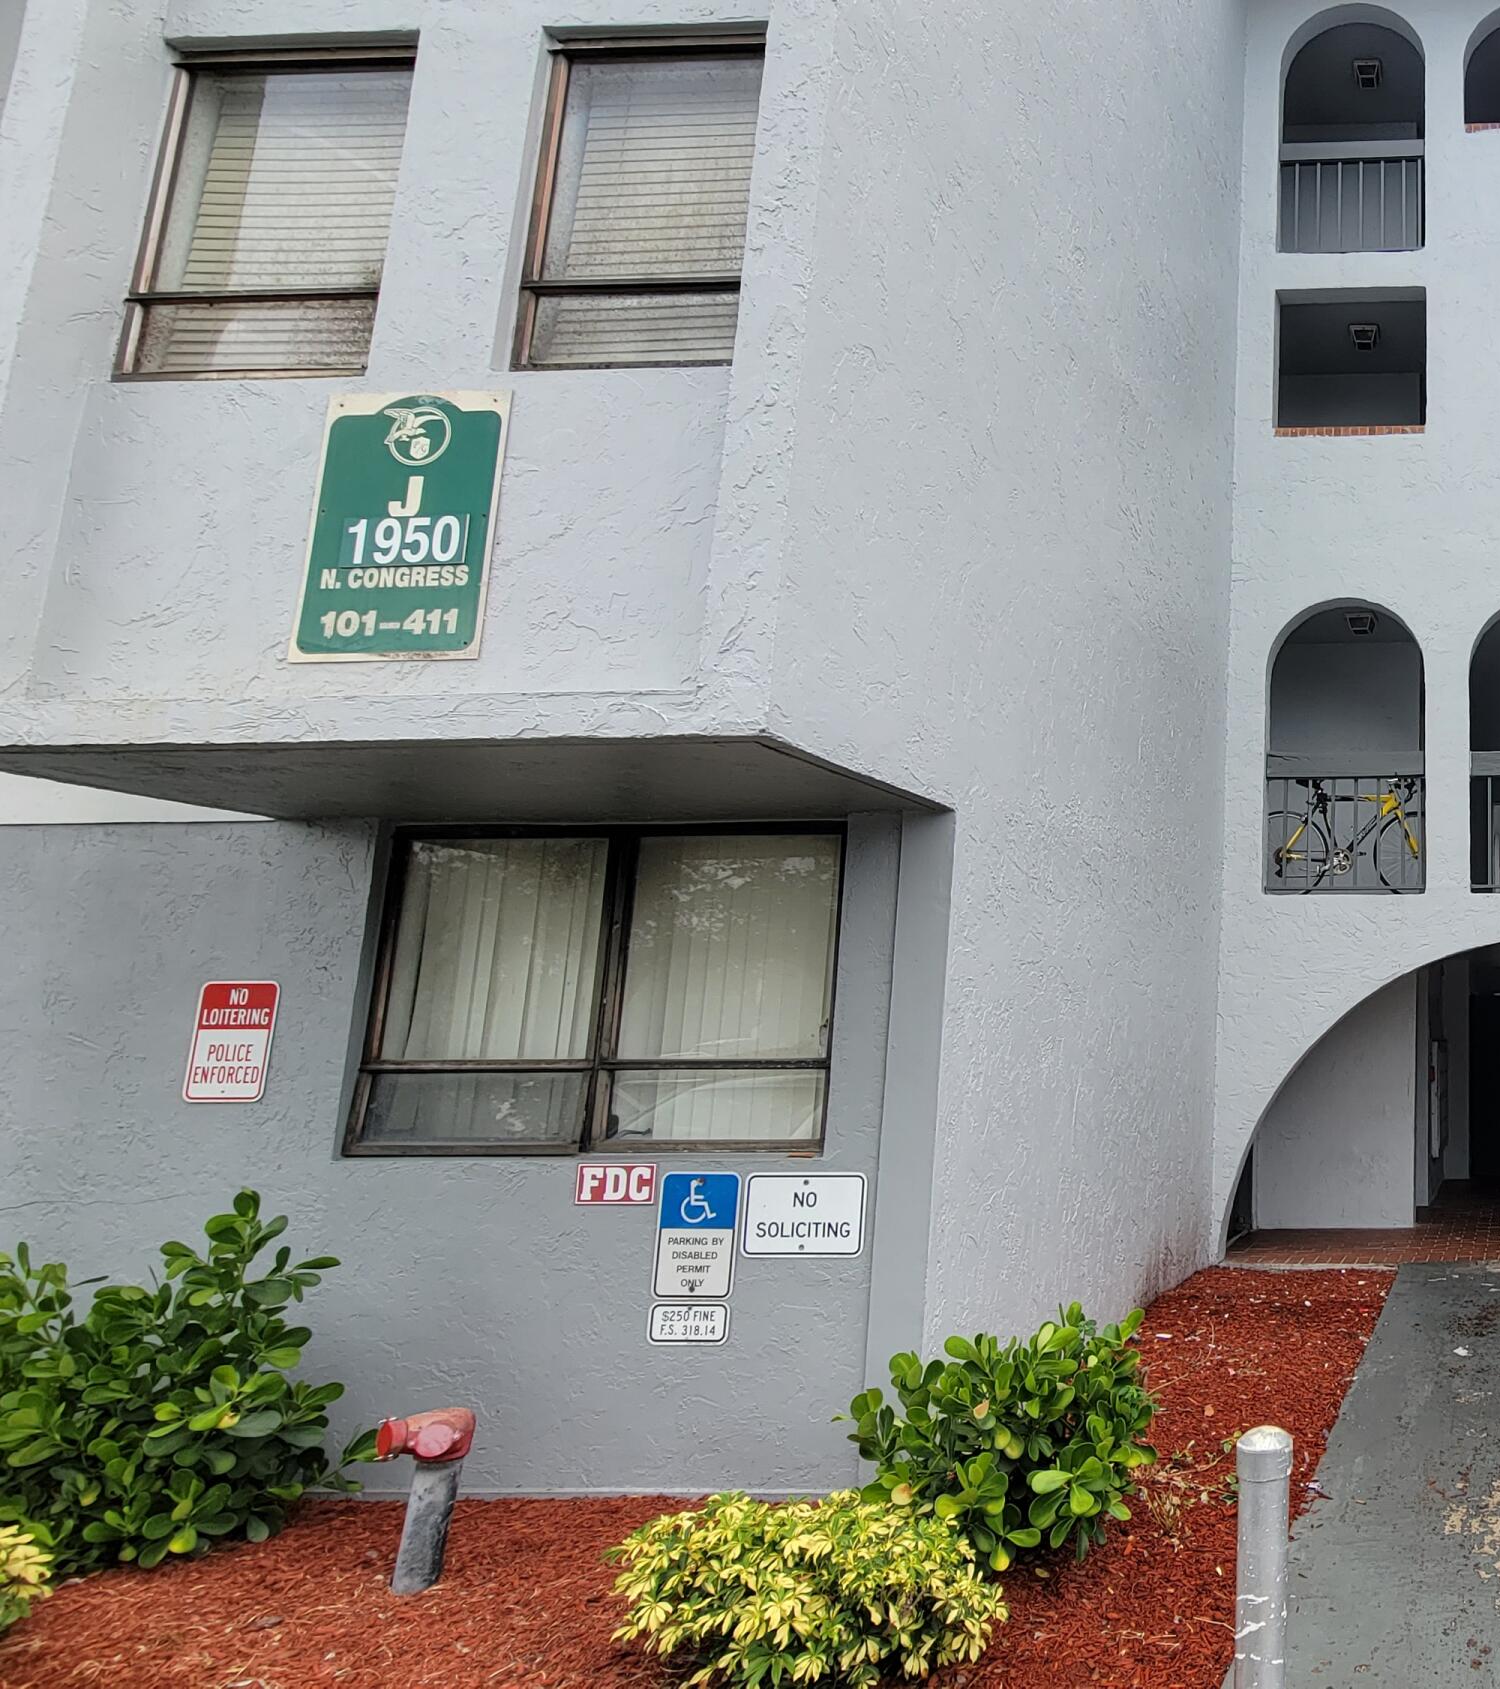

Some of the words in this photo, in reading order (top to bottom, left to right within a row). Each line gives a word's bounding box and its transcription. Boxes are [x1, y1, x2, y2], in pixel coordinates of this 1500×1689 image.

[388, 476, 424, 516] J
[348, 515, 461, 565] 1950
[320, 569, 341, 589] N.
[348, 565, 469, 588] CONGRESS
[320, 608, 459, 639] 101-411
[229, 988, 249, 1005] NO
[202, 1008, 270, 1025] LOITERING
[207, 1044, 254, 1062] POLICE
[192, 1066, 260, 1084] ENFORCED
[580, 1166, 651, 1201] FDC
[792, 1191, 817, 1208] NO
[755, 1222, 851, 1239] SOLICITING
[667, 1237, 708, 1246] PARKING
[711, 1237, 724, 1246] BY
[672, 1251, 718, 1260] DISABLED
[676, 1265, 711, 1273] PERMIT
[680, 1279, 704, 1288] ONLY
[693, 1310, 716, 1322] FINE
[659, 1324, 677, 1336] F.S.
[681, 1324, 716, 1336] 318.14
